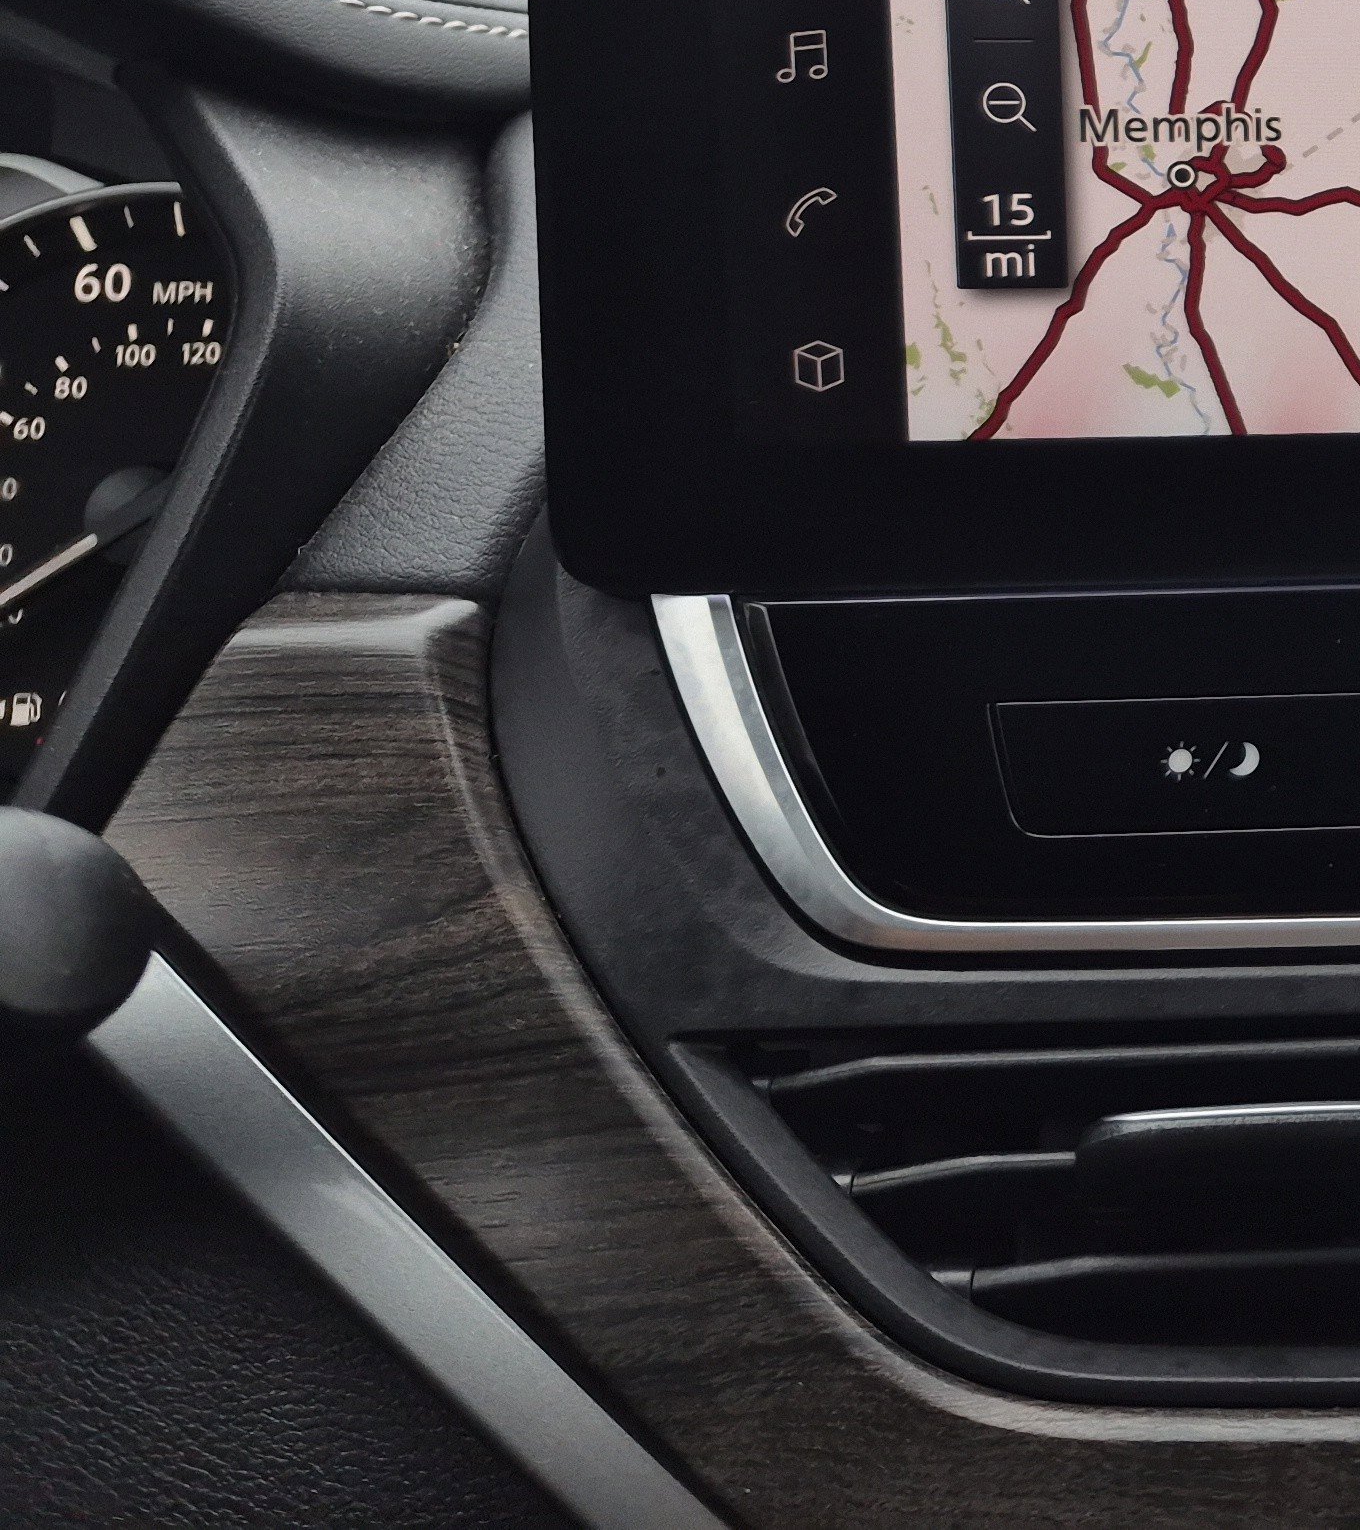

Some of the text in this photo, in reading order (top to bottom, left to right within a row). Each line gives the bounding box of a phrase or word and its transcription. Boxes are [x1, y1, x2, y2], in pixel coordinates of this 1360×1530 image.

[1079, 107, 1282, 152] Memphis
[981, 192, 1035, 227] 15
[985, 244, 1036, 278] mi
[74, 262, 133, 303] 60
[152, 280, 213, 306] MPH
[114, 343, 157, 368] 100
[181, 341, 222, 366] 120
[53, 375, 89, 400] 80
[13, 416, 46, 441] 60
[0, 476, 18, 502] 0
